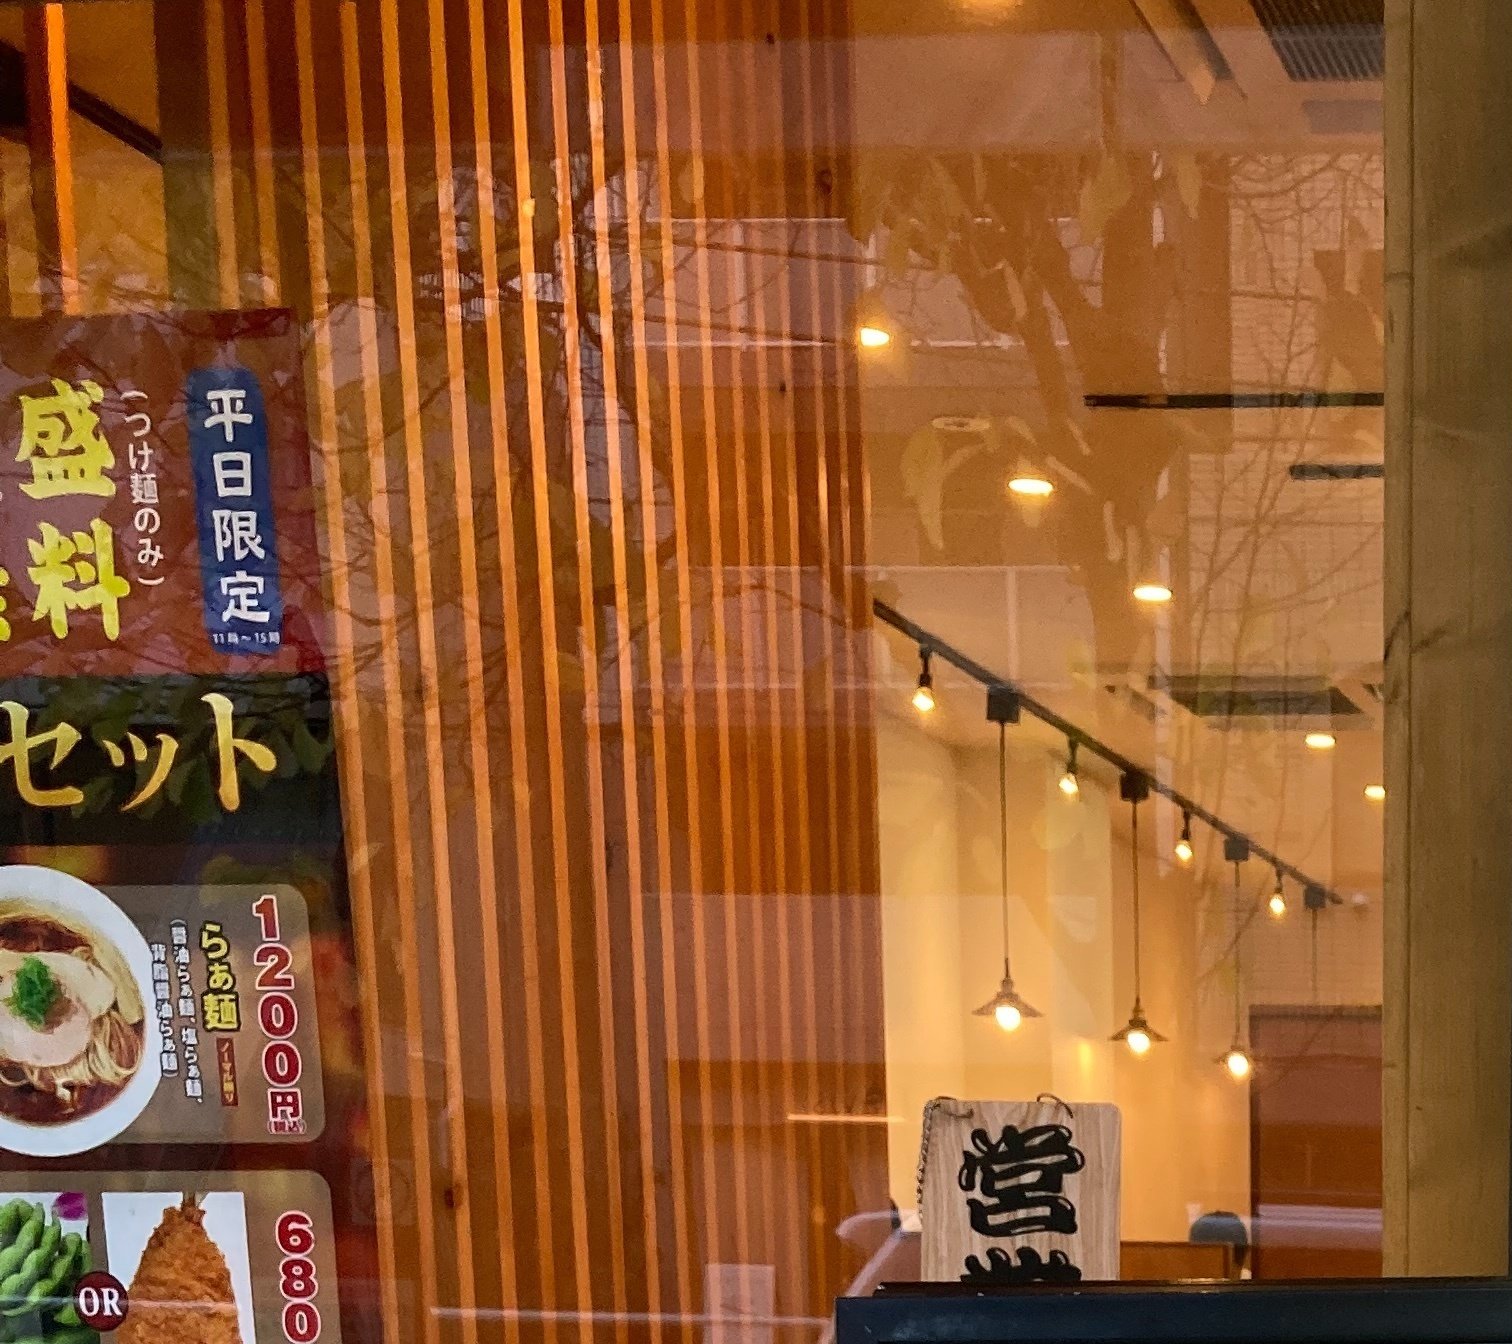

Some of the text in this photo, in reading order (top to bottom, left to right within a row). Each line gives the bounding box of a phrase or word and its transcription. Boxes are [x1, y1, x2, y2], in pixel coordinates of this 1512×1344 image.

[204, 388, 271, 624] 平日限定
[200, 922, 240, 1031] らぁ麺
[251, 894, 303, 1120] 1200円
[79, 1286, 122, 1316] OR
